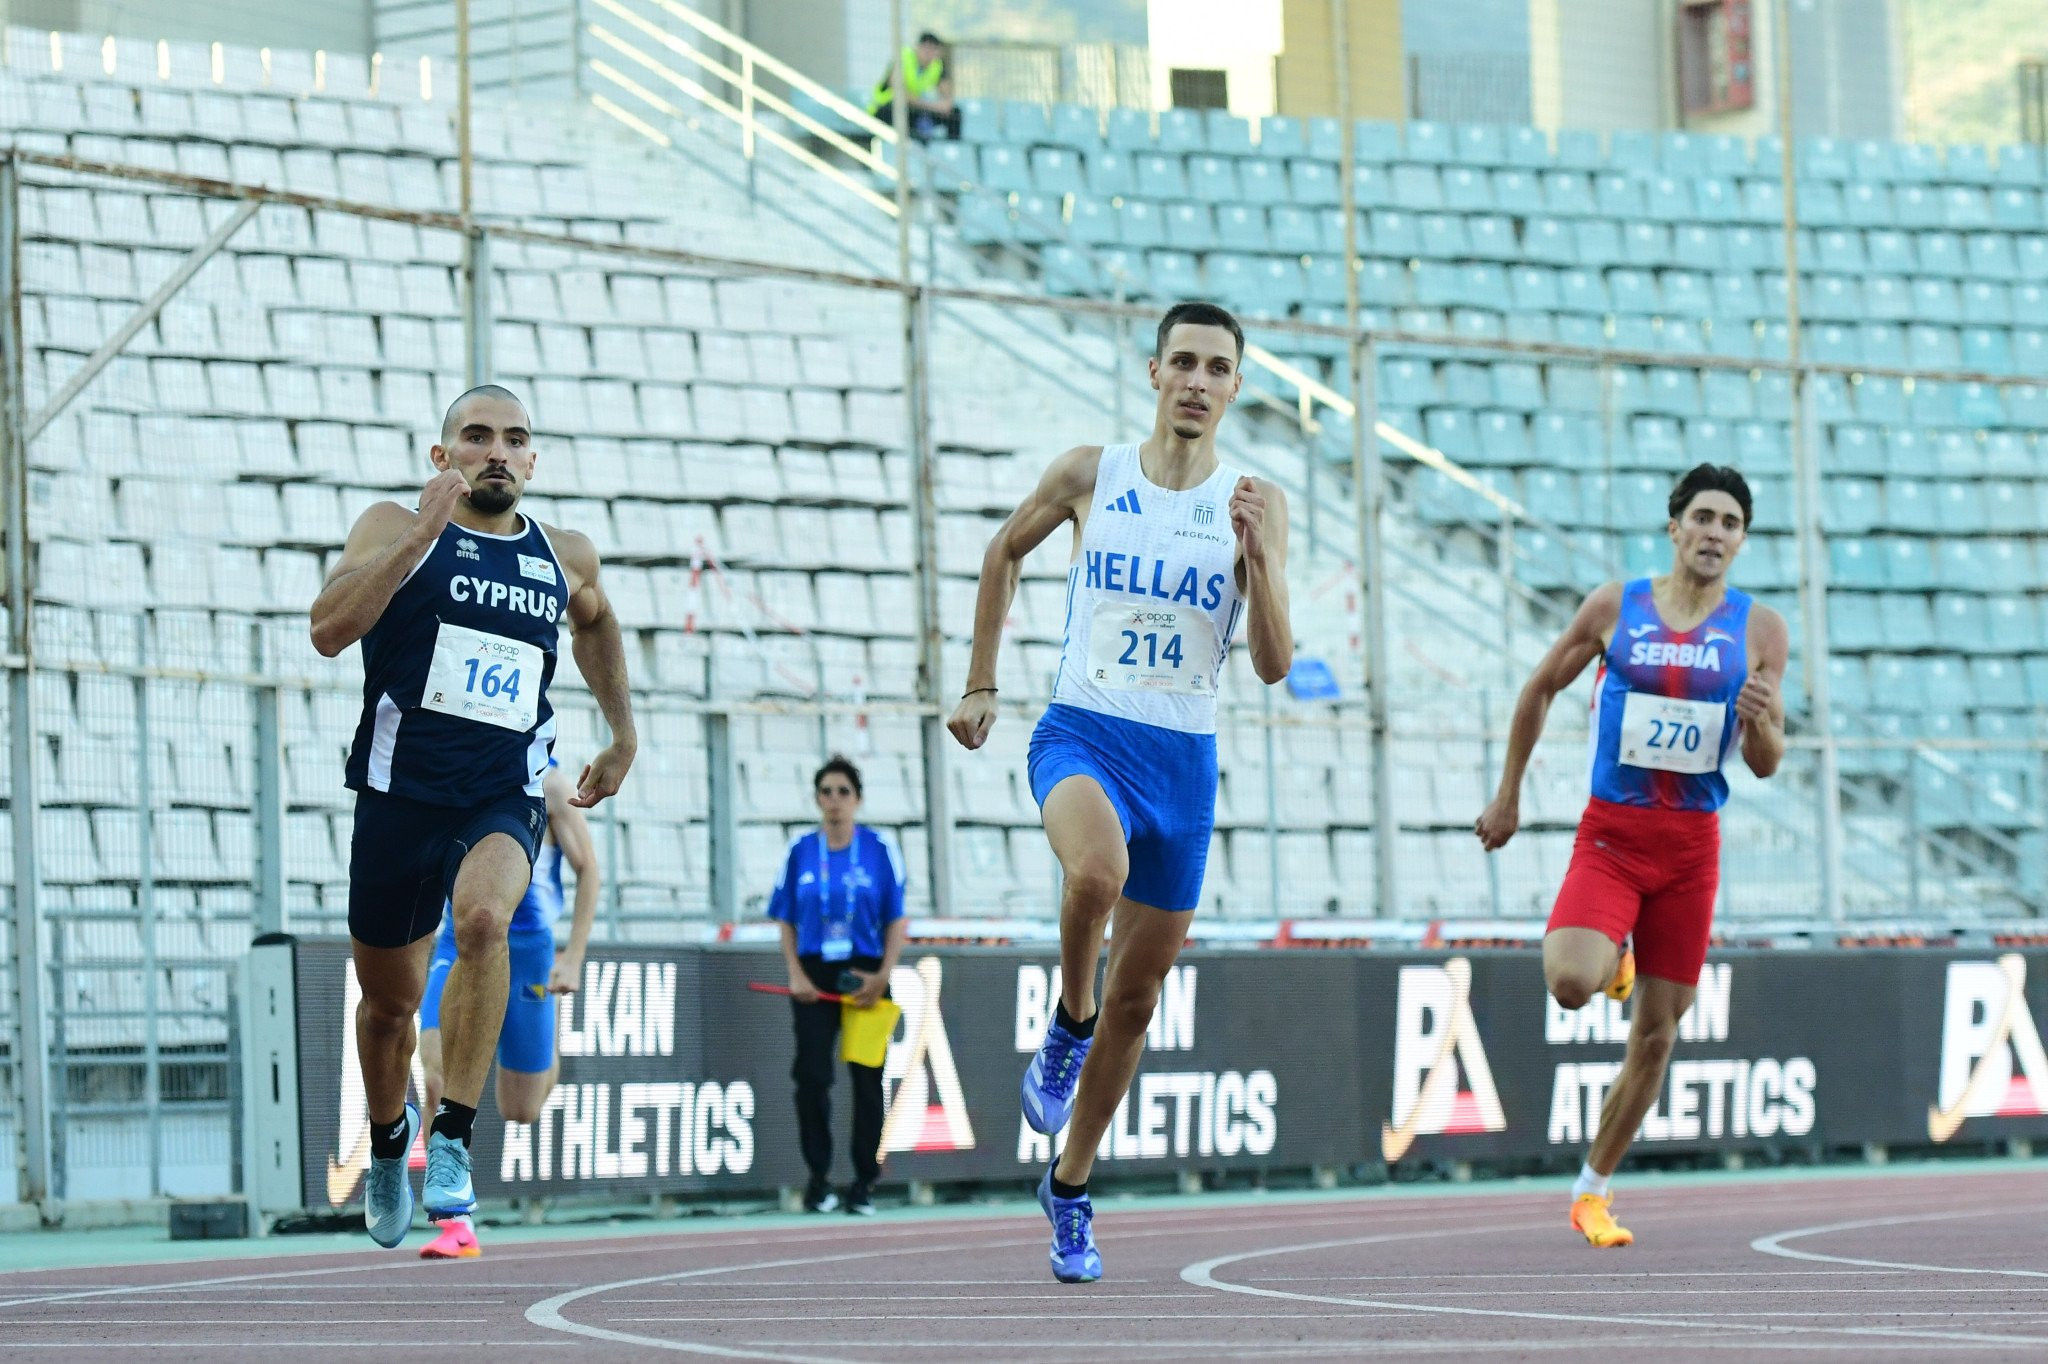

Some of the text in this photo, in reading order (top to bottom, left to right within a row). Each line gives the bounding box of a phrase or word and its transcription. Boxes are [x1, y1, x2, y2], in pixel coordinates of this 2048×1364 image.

[1174, 530, 1220, 543] AEGEAN
[450, 574, 558, 624] CYPRUS
[1085, 550, 1225, 611] HELLAS
[1147, 612, 1177, 624] opap
[493, 643, 520, 658] opap
[1118, 629, 1184, 669] 214
[1629, 641, 1721, 673] SERBIA
[465, 658, 521, 703] 164
[1647, 719, 1702, 752] 270
[558, 961, 677, 1057] LKAN
[1547, 1057, 1817, 1144] ATLETICS
[500, 1081, 755, 1182] ATHLETICS
